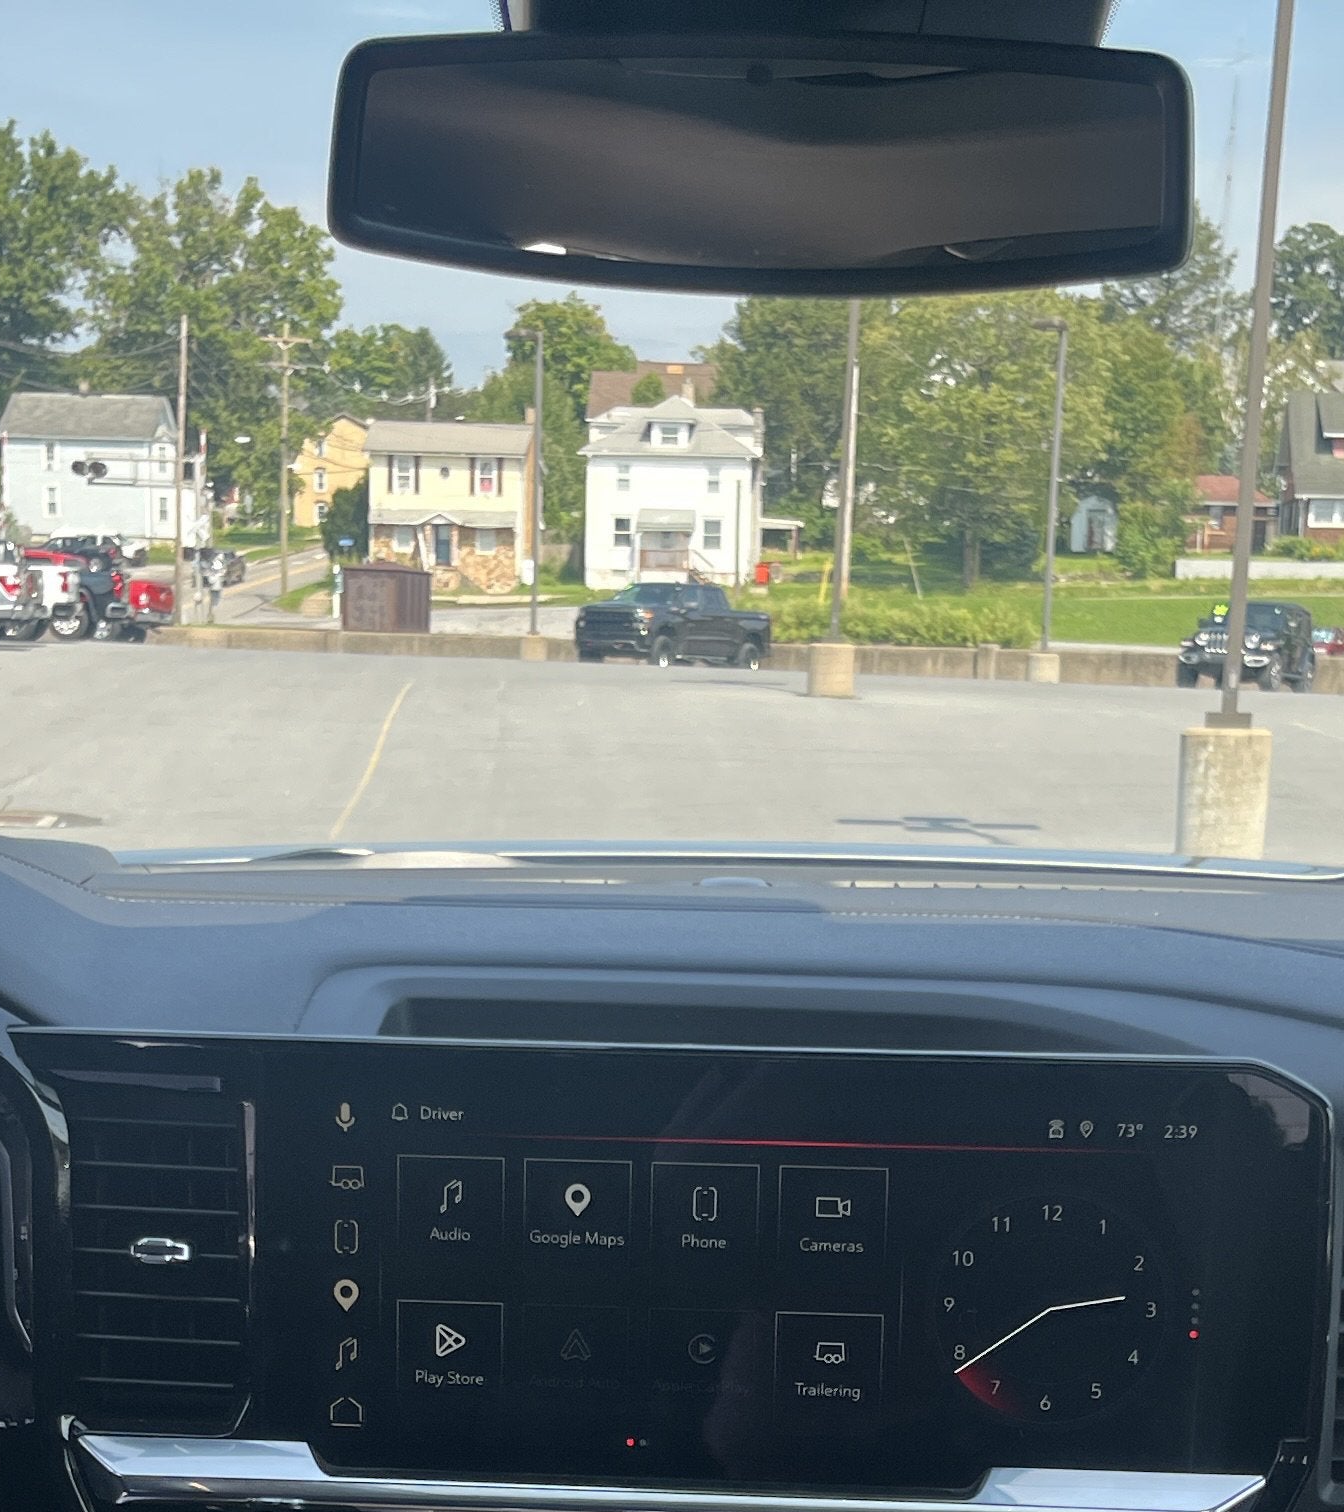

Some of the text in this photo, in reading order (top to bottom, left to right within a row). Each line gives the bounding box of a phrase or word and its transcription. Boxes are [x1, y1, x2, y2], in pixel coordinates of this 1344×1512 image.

[420, 1106, 464, 1121] Driver
[1164, 1125, 1198, 1139] 2:39
[1042, 1204, 1063, 1222] 12
[992, 1216, 1011, 1233] 11
[1099, 1219, 1107, 1235] 1
[430, 1227, 471, 1242] Audio
[529, 1230, 625, 1249] Google Maps
[681, 1235, 727, 1250] Phone
[799, 1237, 864, 1253] Cameras
[952, 1250, 974, 1267] 10
[1133, 1255, 1144, 1271] 2
[943, 1297, 955, 1312] 9
[1145, 1302, 1156, 1318] 3
[953, 1345, 966, 1360] 8
[1127, 1349, 1139, 1365] 4
[415, 1370, 484, 1387] Play Store
[795, 1382, 861, 1402] Trailering
[991, 1380, 1001, 1395] 7
[1090, 1383, 1102, 1399] 5
[1039, 1394, 1051, 1411] 6
